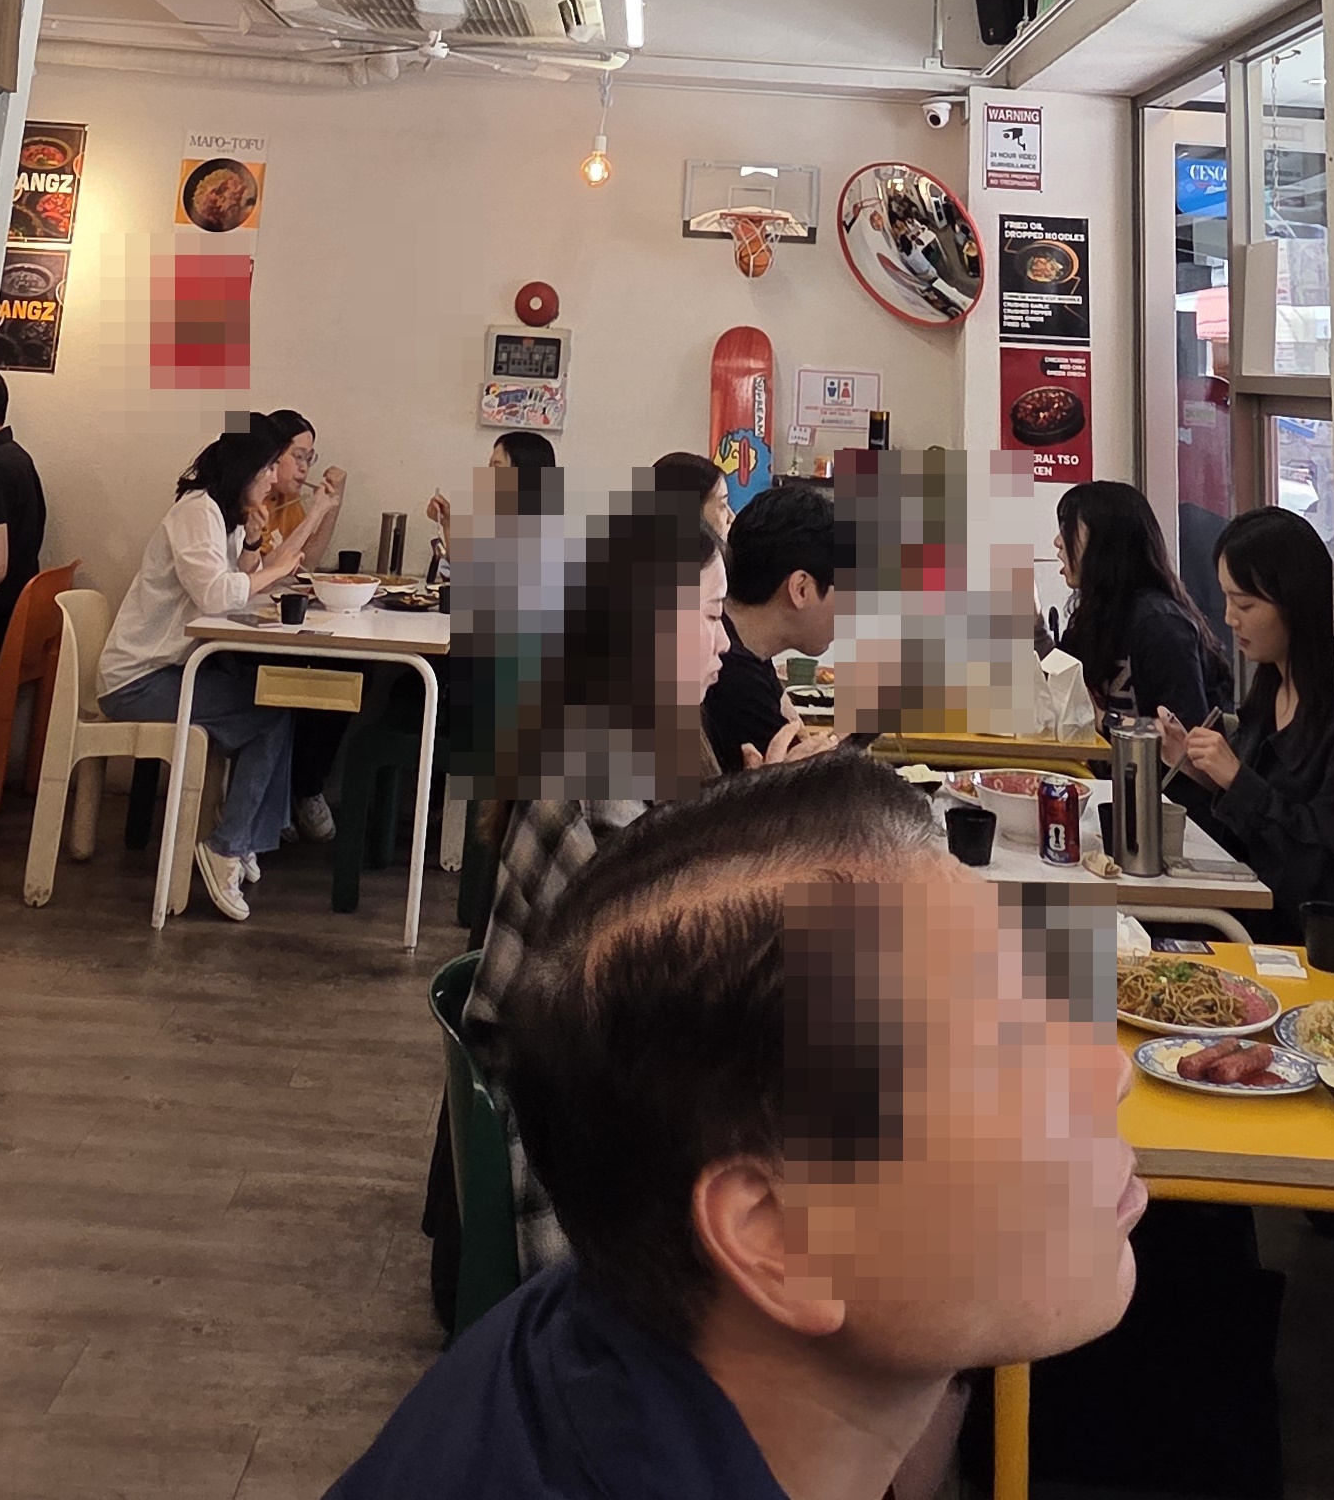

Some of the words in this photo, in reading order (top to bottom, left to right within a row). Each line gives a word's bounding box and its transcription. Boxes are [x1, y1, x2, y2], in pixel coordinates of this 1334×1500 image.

[988, 108, 1040, 123] WARNING
[189, 135, 265, 151] MAPO-TOFU
[1018, 153, 1037, 161] VIDEO
[1189, 164, 1227, 181] CESC
[15, 172, 74, 193] ANGZ
[1004, 230, 1044, 239] DROPPED
[1044, 232, 1085, 242] NOODLES
[1056, 454, 1079, 466] TSO
